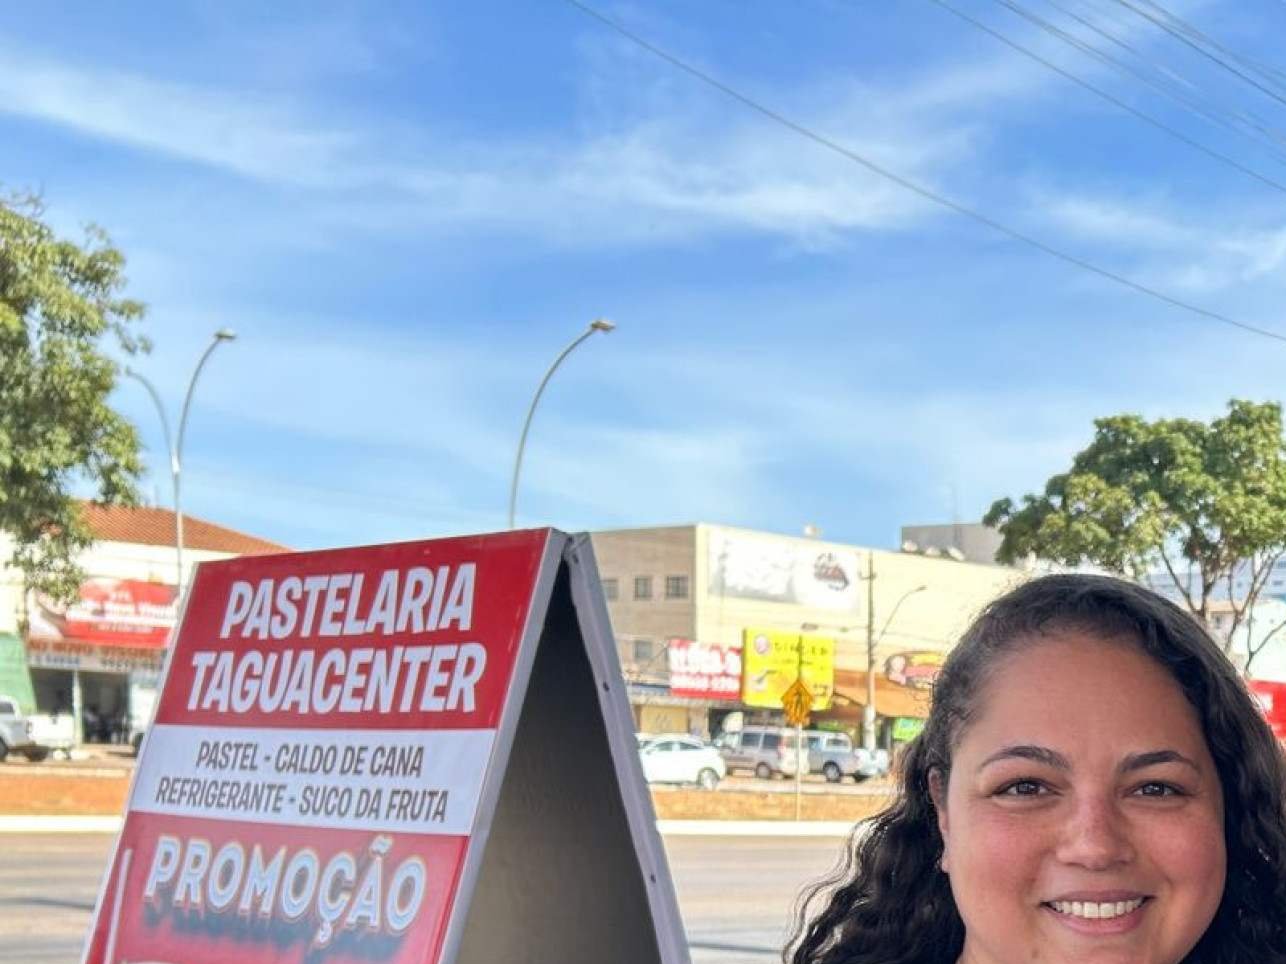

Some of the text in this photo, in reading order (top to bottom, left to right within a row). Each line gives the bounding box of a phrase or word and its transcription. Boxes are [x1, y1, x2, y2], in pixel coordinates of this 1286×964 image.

[220, 562, 477, 640] PASTELARIA
[187, 643, 488, 714] TAGUACENTER
[195, 741, 259, 771] PASTEL
[274, 745, 337, 775] CALDO
[338, 747, 368, 776] DE
[369, 746, 425, 778] CANA
[155, 776, 288, 813] REFRIGERANTE
[298, 785, 353, 818] SUCO
[354, 787, 384, 820] DA
[385, 789, 449, 823] FRUTA
[143, 834, 429, 946] PROMOÇÃO
